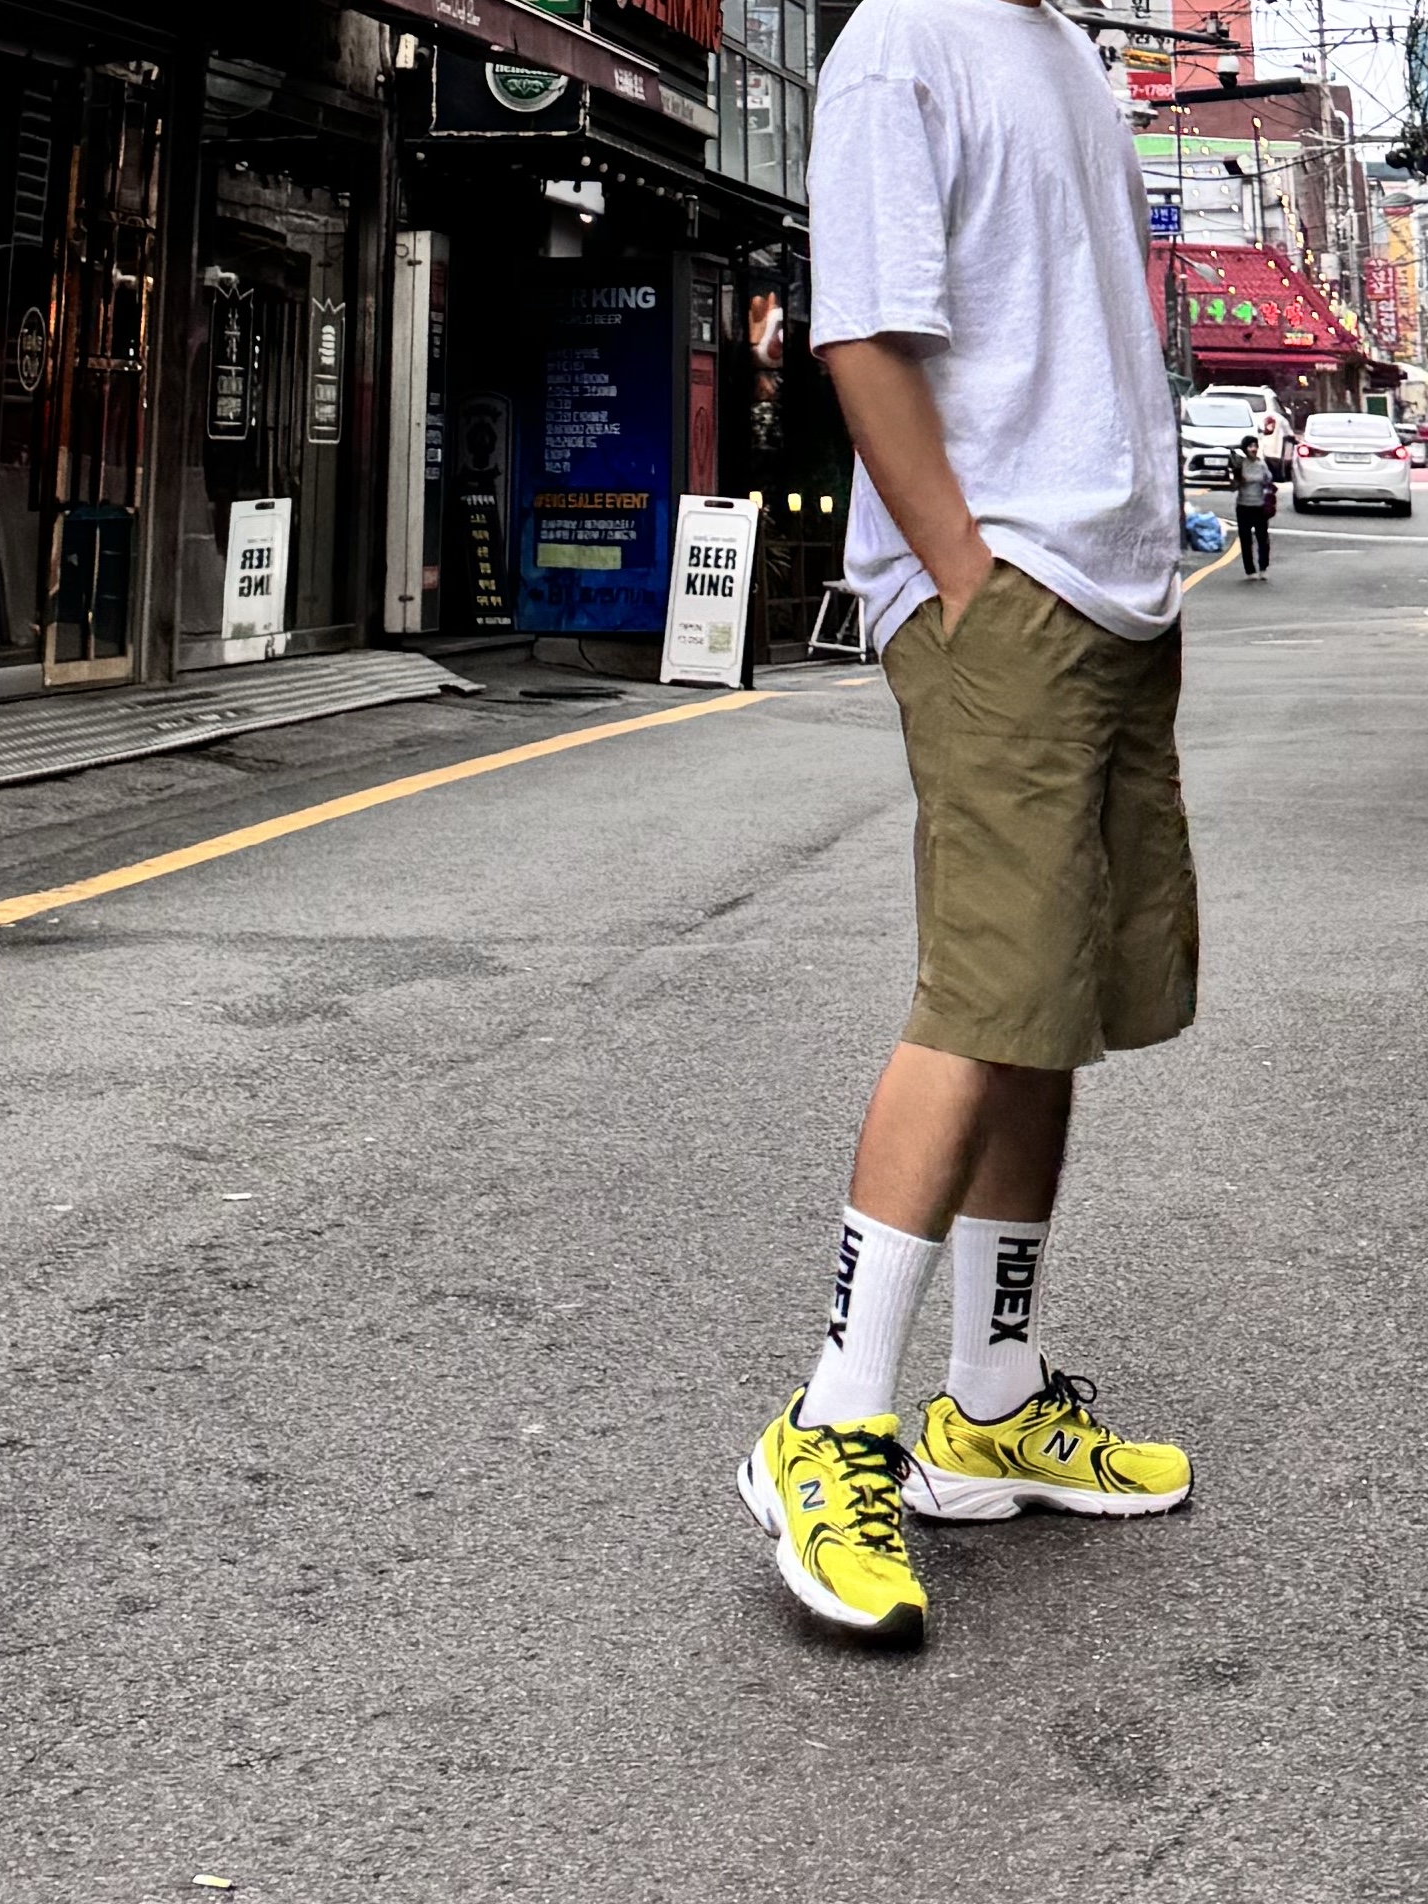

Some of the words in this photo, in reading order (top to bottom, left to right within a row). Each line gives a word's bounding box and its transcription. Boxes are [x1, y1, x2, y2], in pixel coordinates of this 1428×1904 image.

[591, 285, 657, 310] KING
[606, 492, 651, 510] EVENT
[688, 544, 738, 572] BEER
[685, 570, 734, 600] KING
[988, 1235, 1042, 1346] HDEX
[1042, 1428, 1083, 1466] N
[799, 1479, 826, 1513] N
